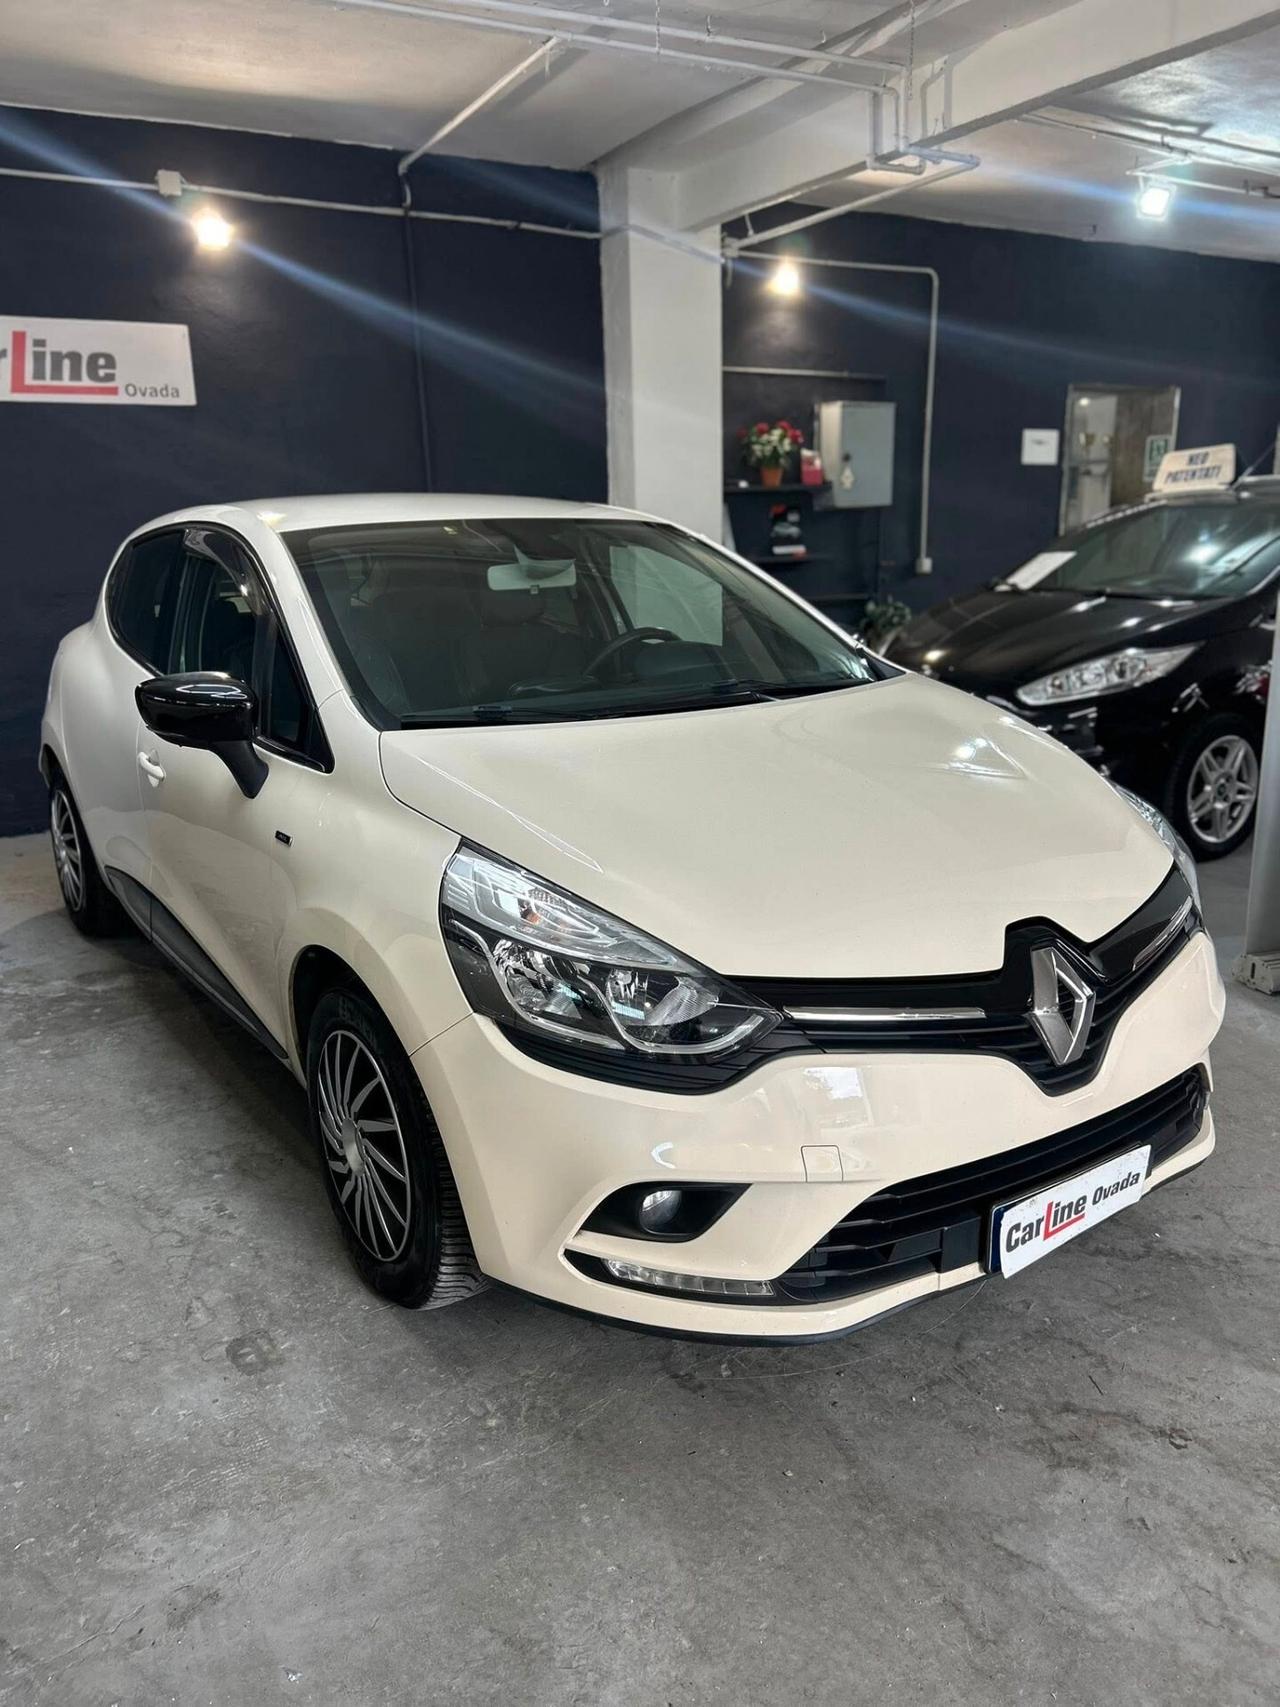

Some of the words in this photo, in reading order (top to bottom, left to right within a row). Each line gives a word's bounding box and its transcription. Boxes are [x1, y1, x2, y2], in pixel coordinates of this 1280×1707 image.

[125, 383, 180, 398] Ovada
[1005, 1195, 1087, 1253] CarLine
[1092, 1171, 1141, 1206] Ovada
